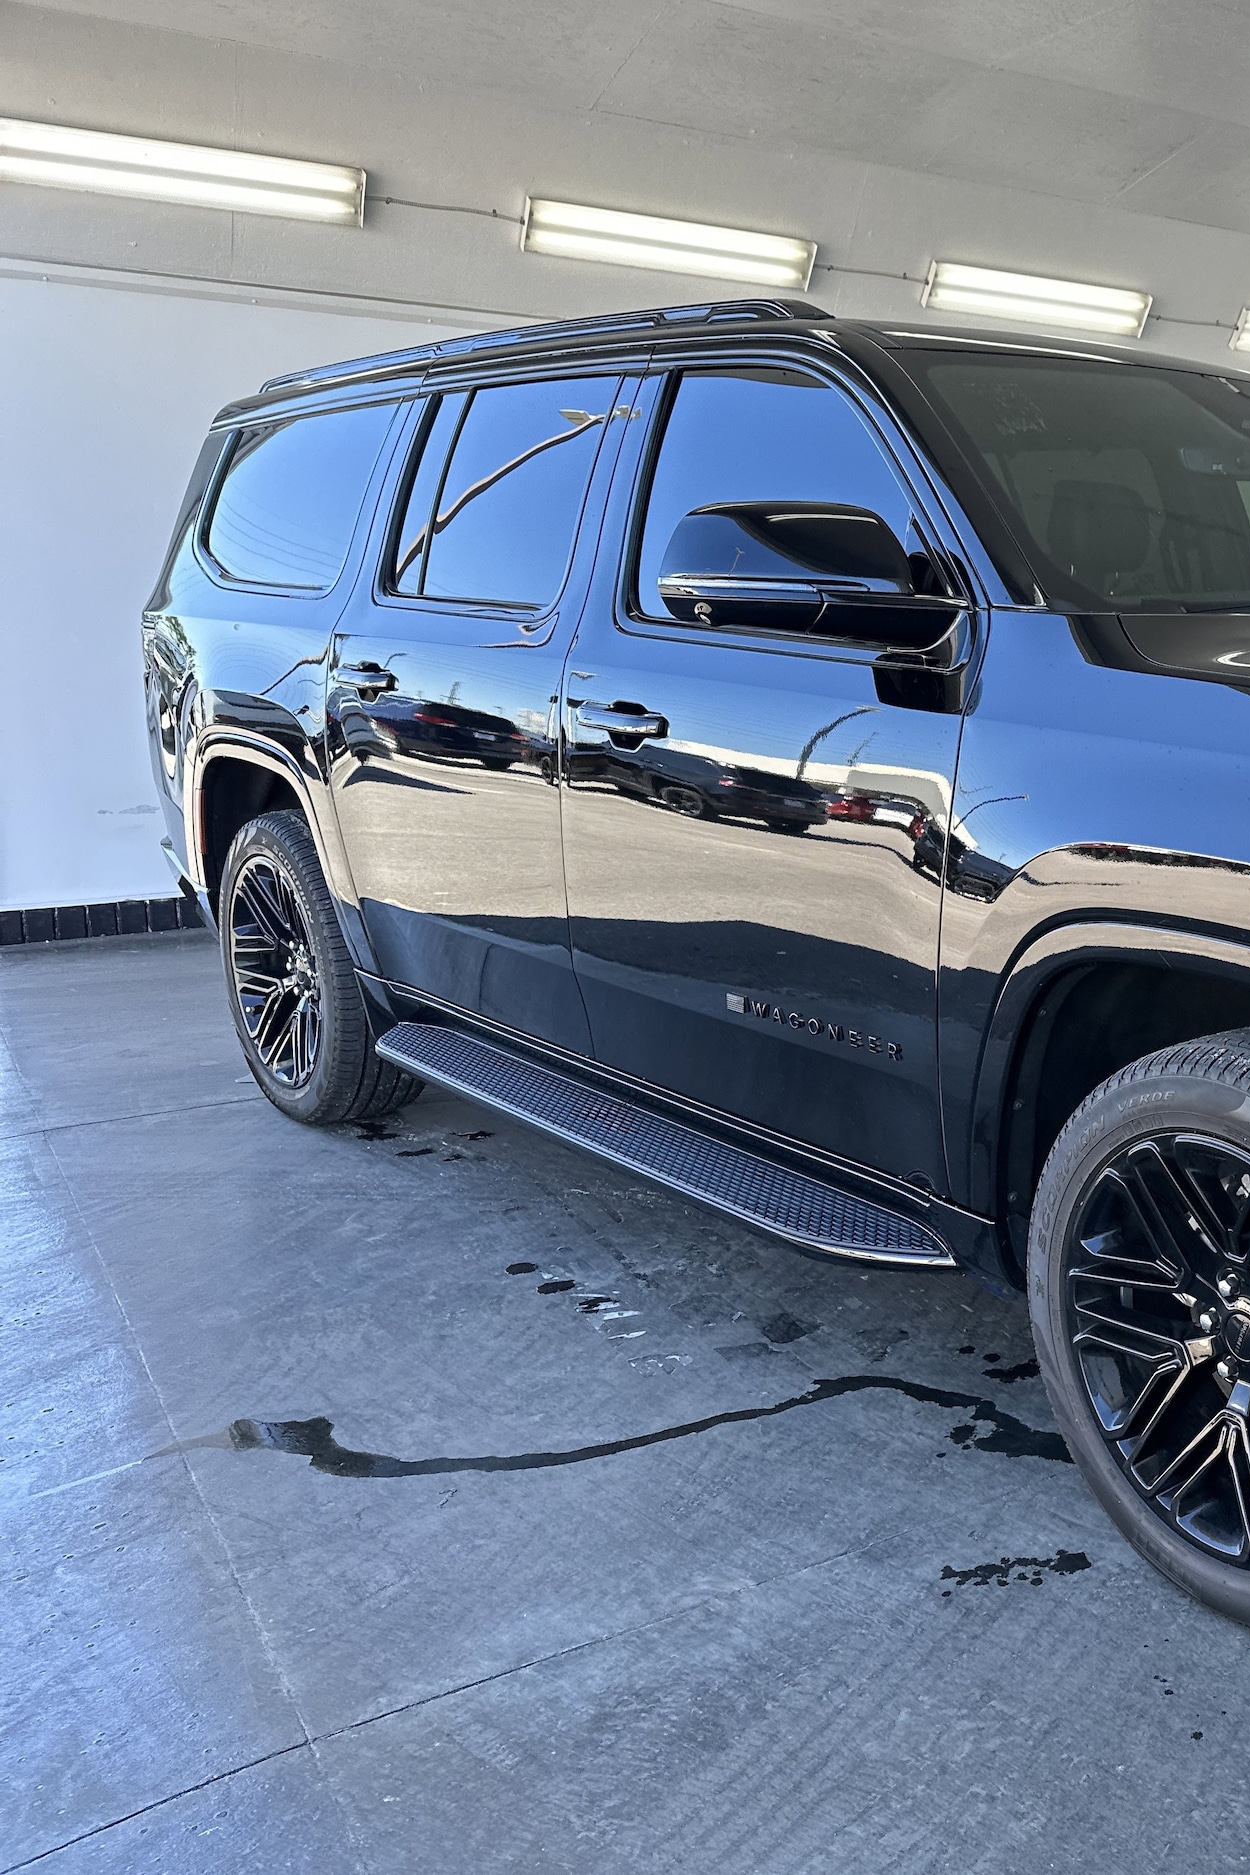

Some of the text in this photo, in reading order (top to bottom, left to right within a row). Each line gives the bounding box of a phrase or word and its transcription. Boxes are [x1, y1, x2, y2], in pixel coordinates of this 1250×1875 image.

[751, 1001, 903, 1061] WAGONEER
[1037, 1090, 1176, 1255] SCORPION VERDE
